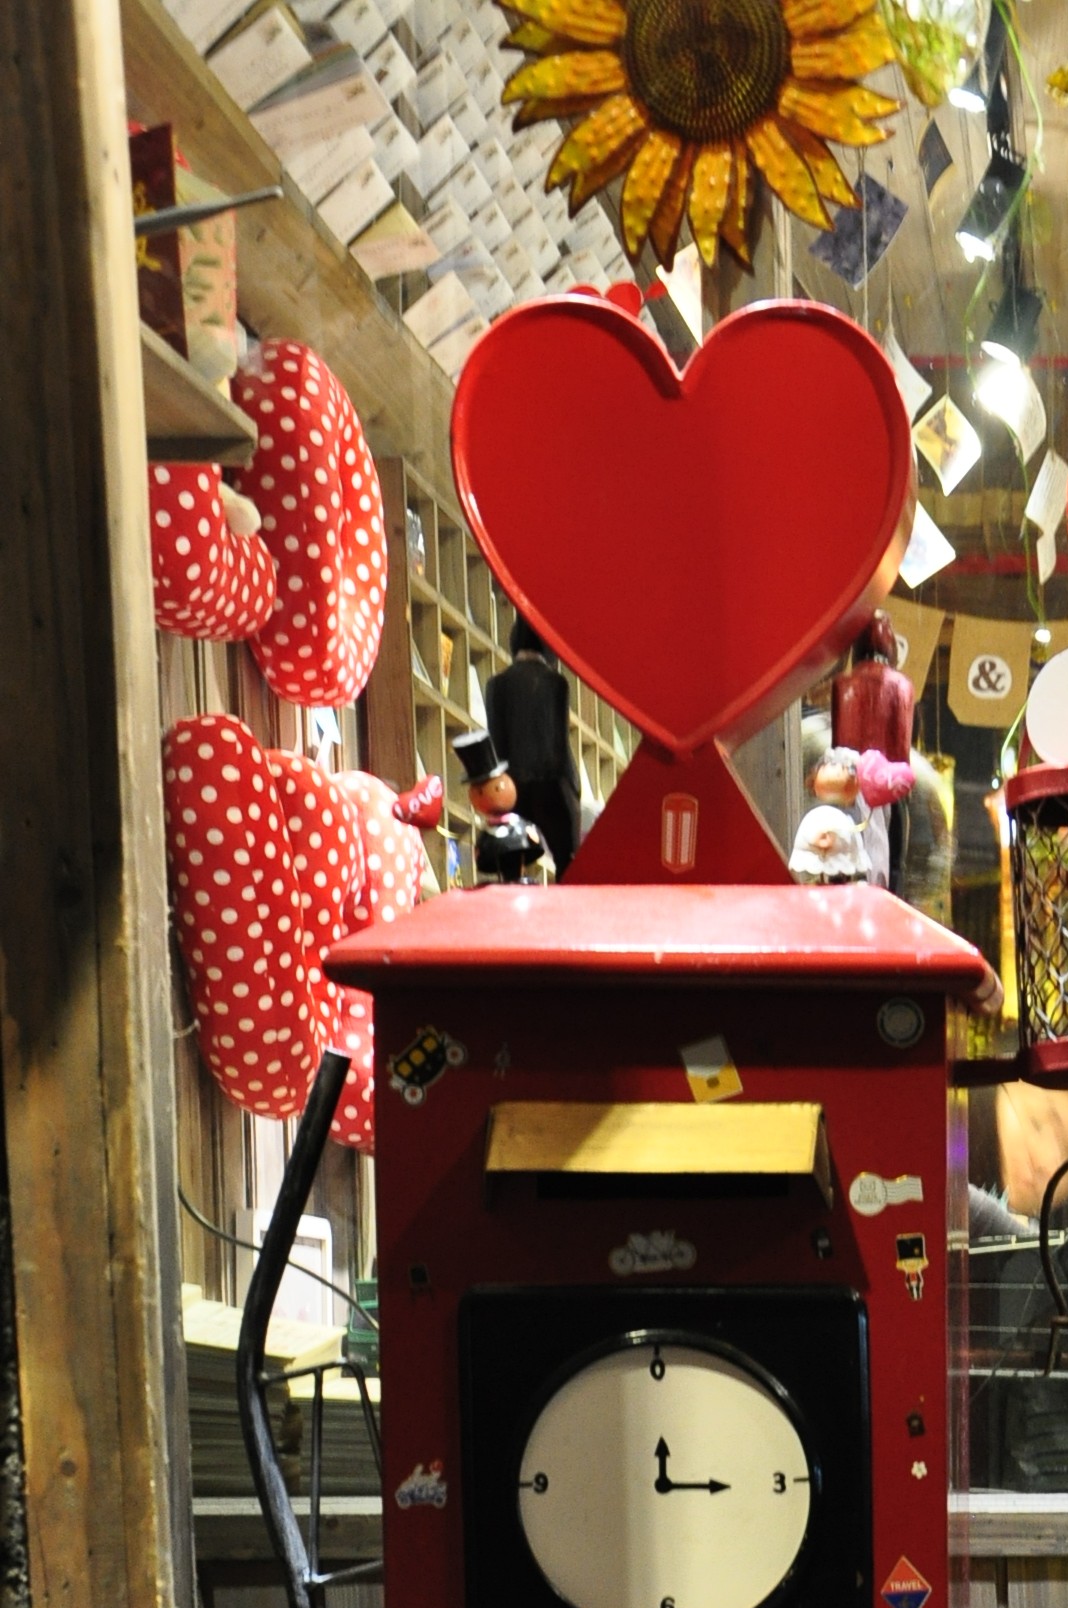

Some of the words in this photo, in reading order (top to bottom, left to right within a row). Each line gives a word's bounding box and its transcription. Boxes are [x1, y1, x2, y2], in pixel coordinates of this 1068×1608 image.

[533, 1473, 549, 1493] 9
[773, 1473, 787, 1494] 3
[890, 1580, 921, 1593] TRAVEL
